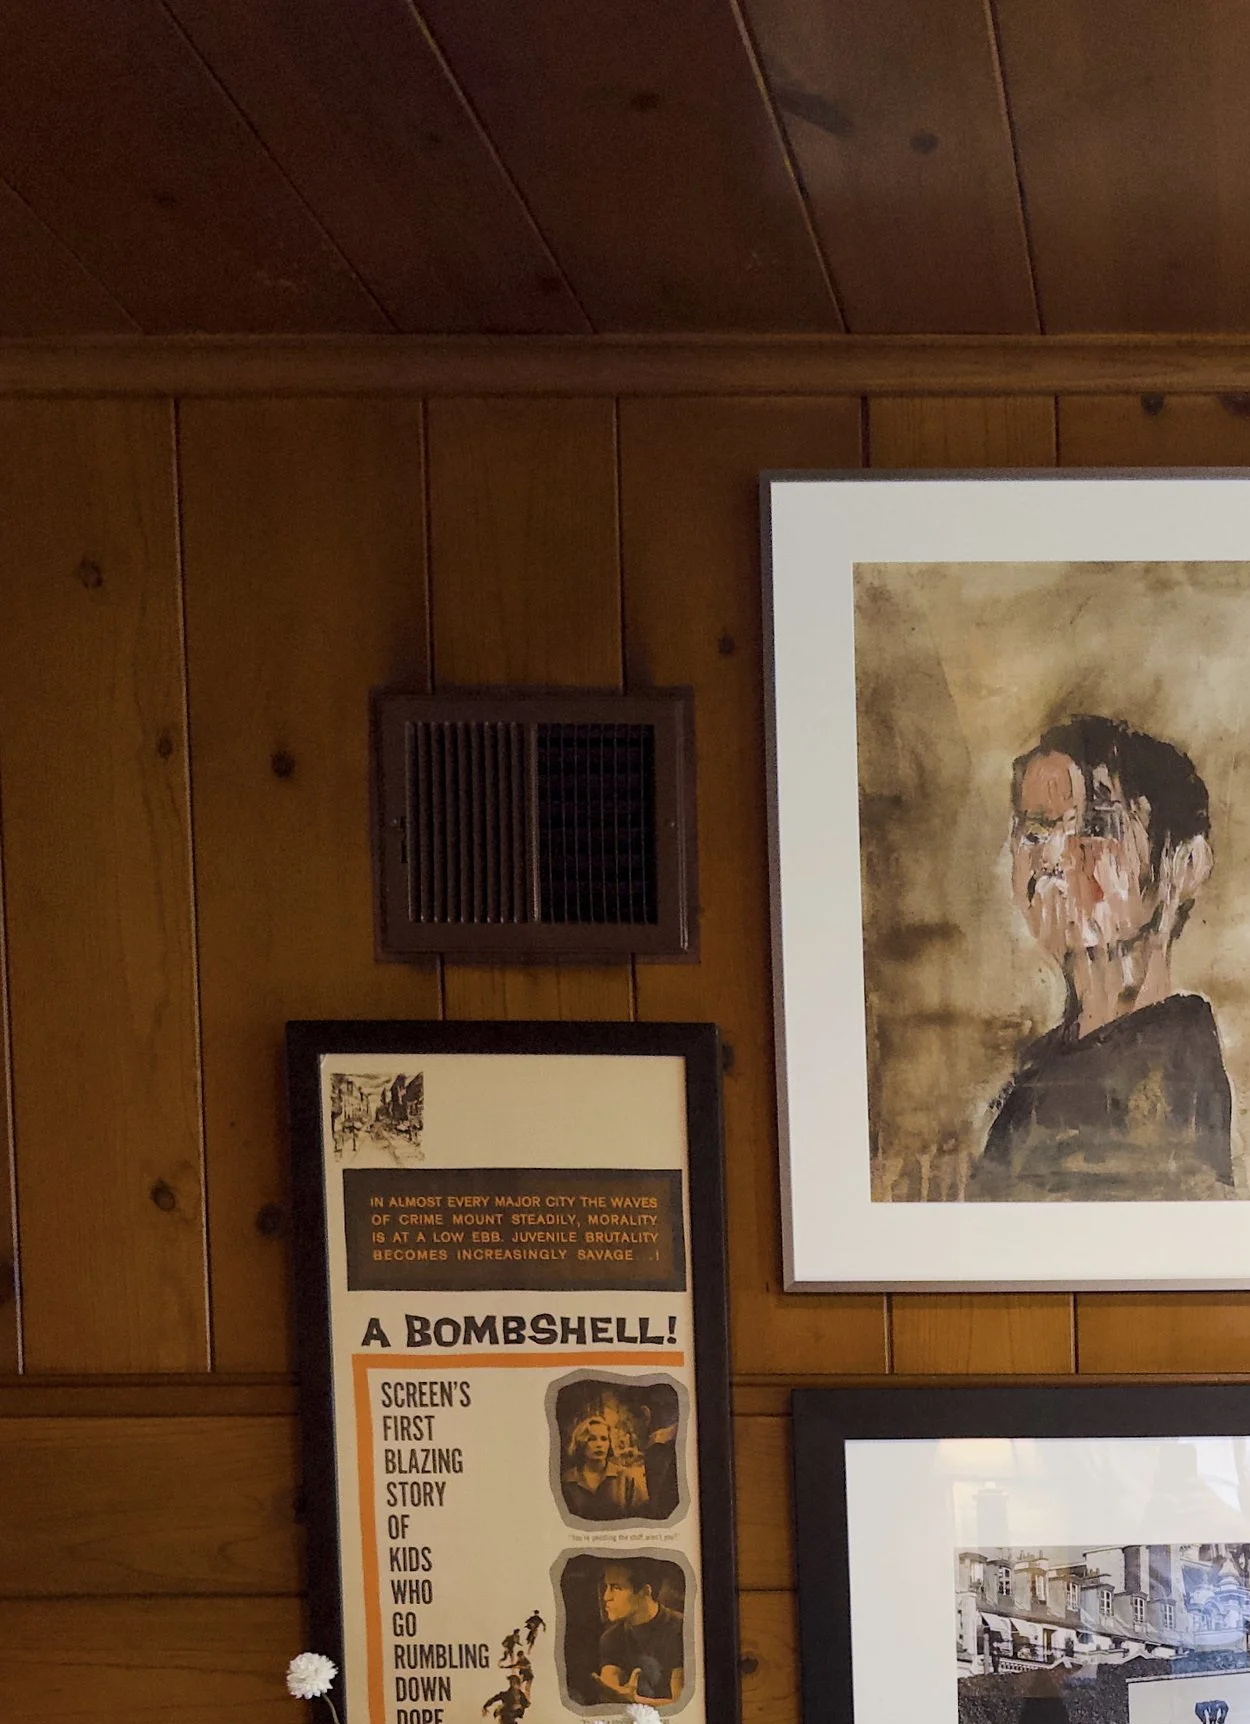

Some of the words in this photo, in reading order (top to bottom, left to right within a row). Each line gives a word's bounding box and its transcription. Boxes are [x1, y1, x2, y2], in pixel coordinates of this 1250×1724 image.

[370, 1196, 384, 1208] IN
[389, 1196, 442, 1208] ALMOST
[447, 1196, 490, 1208] EVERY
[495, 1196, 541, 1208] MAJOR
[546, 1196, 577, 1208] CITY
[580, 1196, 605, 1208] THE
[611, 1196, 657, 1208] WAVES
[372, 1213, 391, 1226] OF
[399, 1213, 443, 1226] CRIME
[453, 1213, 502, 1226] MOUNT
[511, 1213, 581, 1226] STEADILY,
[588, 1213, 657, 1226] MORALITY
[372, 1231, 386, 1243] IS
[393, 1231, 410, 1243] AT
[416, 1231, 426, 1243] A
[433, 1231, 464, 1243] LOW
[472, 1231, 504, 1243] EBB.
[512, 1231, 577, 1243] JUVENILE
[585, 1231, 659, 1243] BRUTALITY
[373, 1249, 448, 1261] BECOMES
[457, 1248, 567, 1260] INCREASINGLY
[361, 1317, 391, 1348] A
[405, 1313, 677, 1348] BOMBSHELL!
[381, 1381, 471, 1408] SCREEN'S
[383, 1415, 435, 1441] FIRST
[384, 1449, 463, 1475] BLAZING
[386, 1481, 447, 1508] STORY
[388, 1514, 410, 1540] OF
[389, 1546, 433, 1573] KIDS
[391, 1579, 433, 1605] WHO
[393, 1612, 417, 1637] GO
[394, 1644, 490, 1670] RUMBLING
[396, 1677, 451, 1702] DOWN
